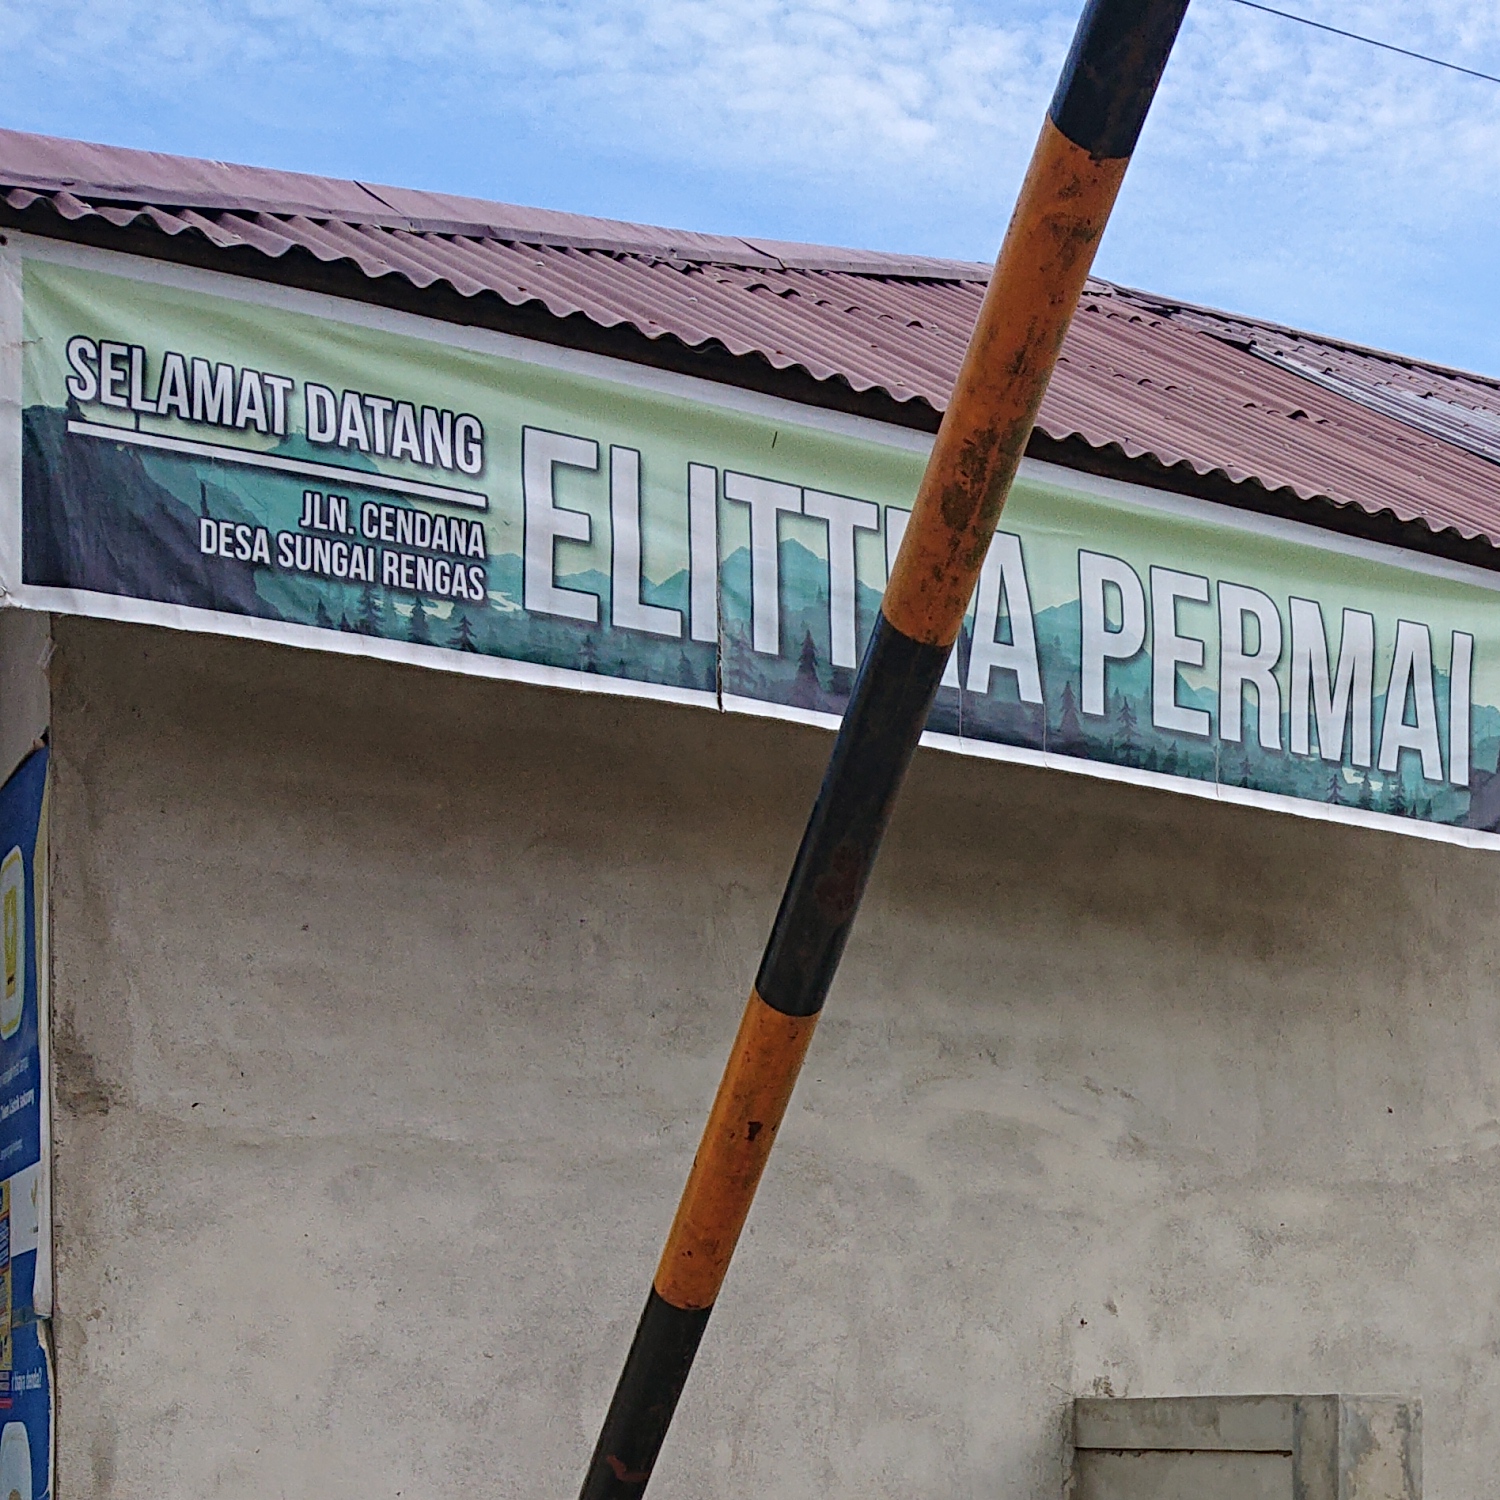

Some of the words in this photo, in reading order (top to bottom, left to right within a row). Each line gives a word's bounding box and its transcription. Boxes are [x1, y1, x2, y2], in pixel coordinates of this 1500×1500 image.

[66, 335, 293, 436] SELAMAT
[305, 383, 485, 475] DATANG
[200, 518, 270, 564] DESA
[278, 532, 375, 582] SUNGAI
[382, 550, 486, 601] RENGAS
[300, 491, 355, 535] JLN.
[362, 504, 486, 559] CENDANA
[522, 425, 1044, 704] ELITTA
[1077, 548, 1474, 787] PERMAI
